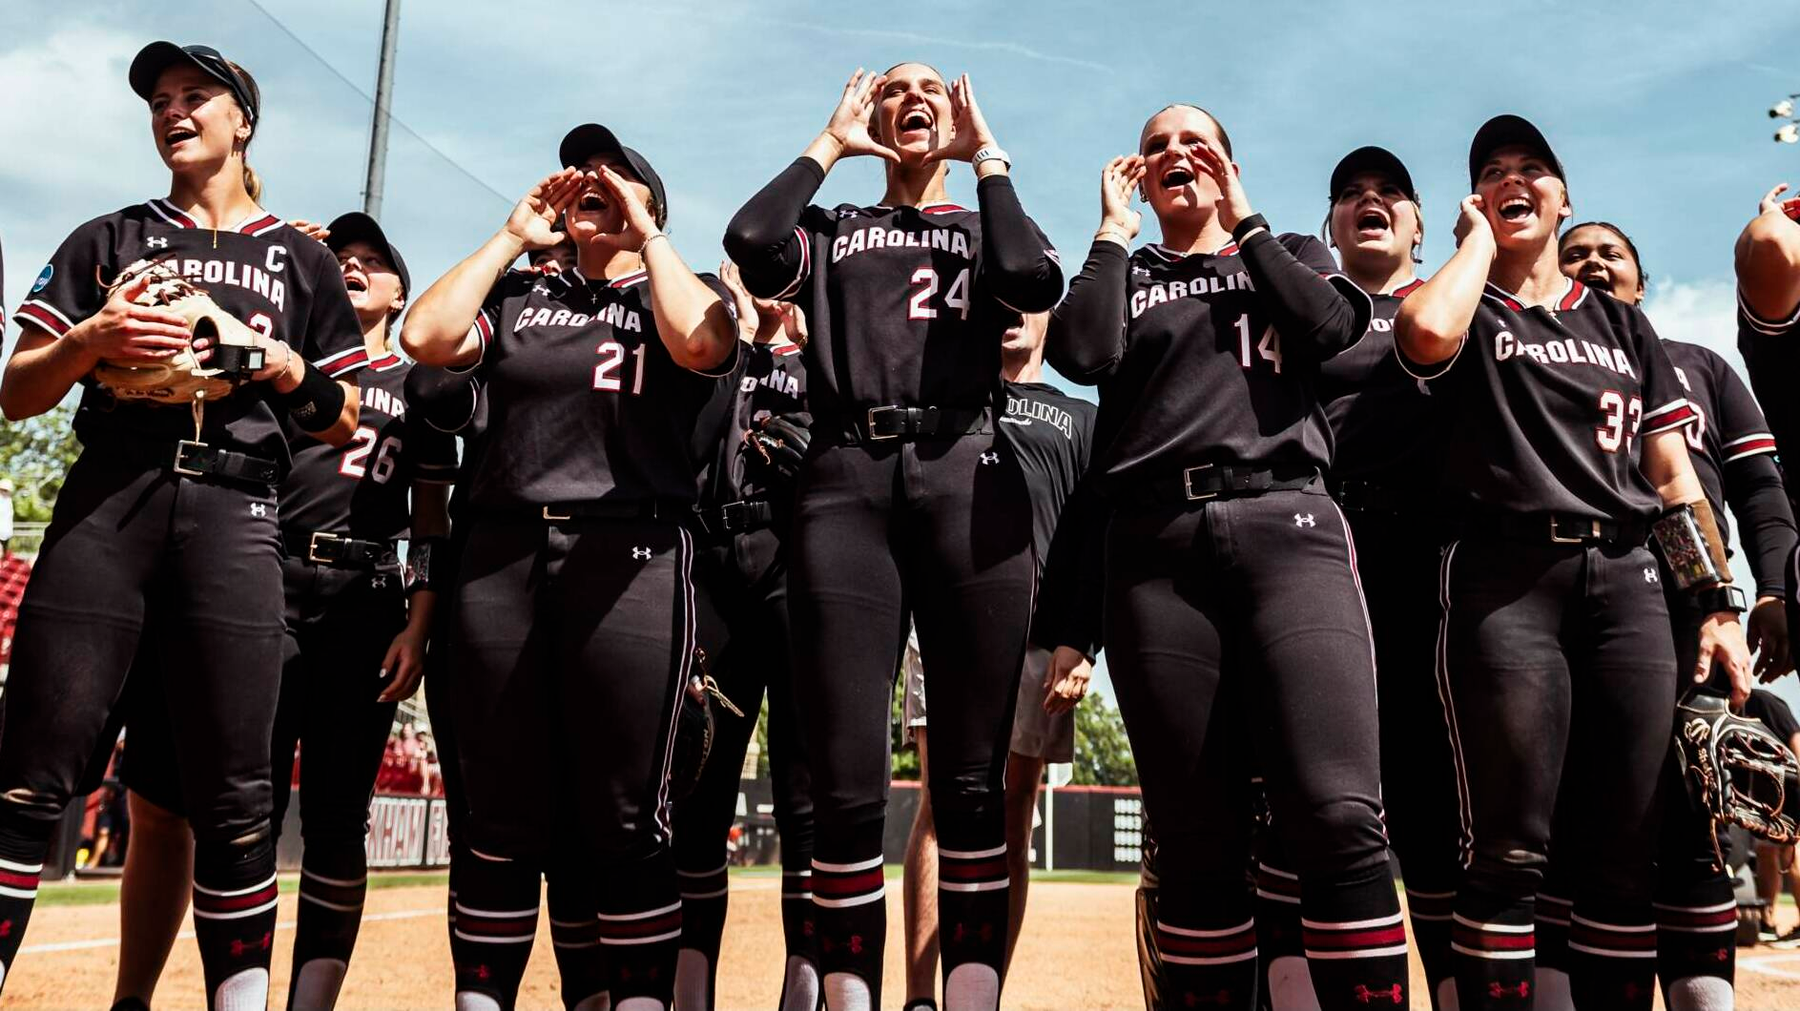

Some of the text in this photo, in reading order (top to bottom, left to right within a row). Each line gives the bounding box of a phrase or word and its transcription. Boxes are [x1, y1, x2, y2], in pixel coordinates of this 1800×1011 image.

[265, 245, 287, 273] C
[832, 226, 969, 264] CAROLINA
[164, 259, 285, 313] AROLINA
[909, 267, 971, 321] 24
[1130, 271, 1257, 319] CAROLIN
[592, 341, 646, 395] 21
[1234, 313, 1283, 374] 14
[1006, 398, 1072, 439] OLINA
[340, 427, 402, 484] 26
